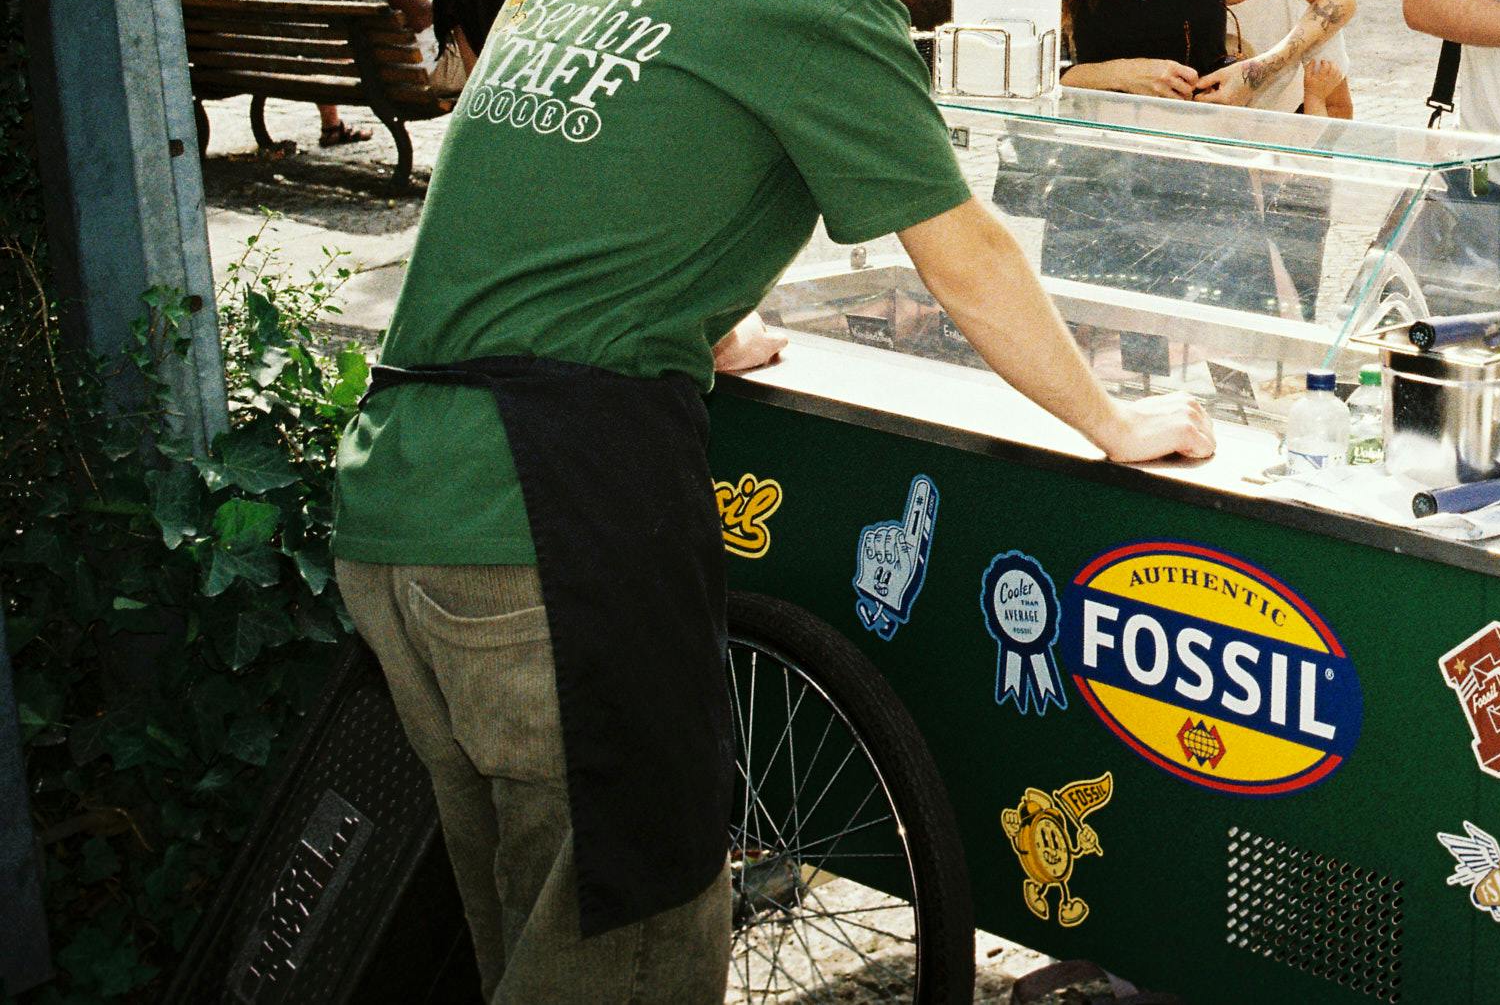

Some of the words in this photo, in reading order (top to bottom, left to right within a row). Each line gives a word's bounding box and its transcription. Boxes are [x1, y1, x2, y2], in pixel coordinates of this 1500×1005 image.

[467, 86, 601, 143] OULES
[1000, 578, 1034, 604] Cooler
[1128, 566, 1288, 628] AUTHENTIC
[1004, 609, 1039, 623] AVERAGE
[1472, 682, 1499, 715] Fossil
[1067, 784, 1107, 812] FOSSIL
